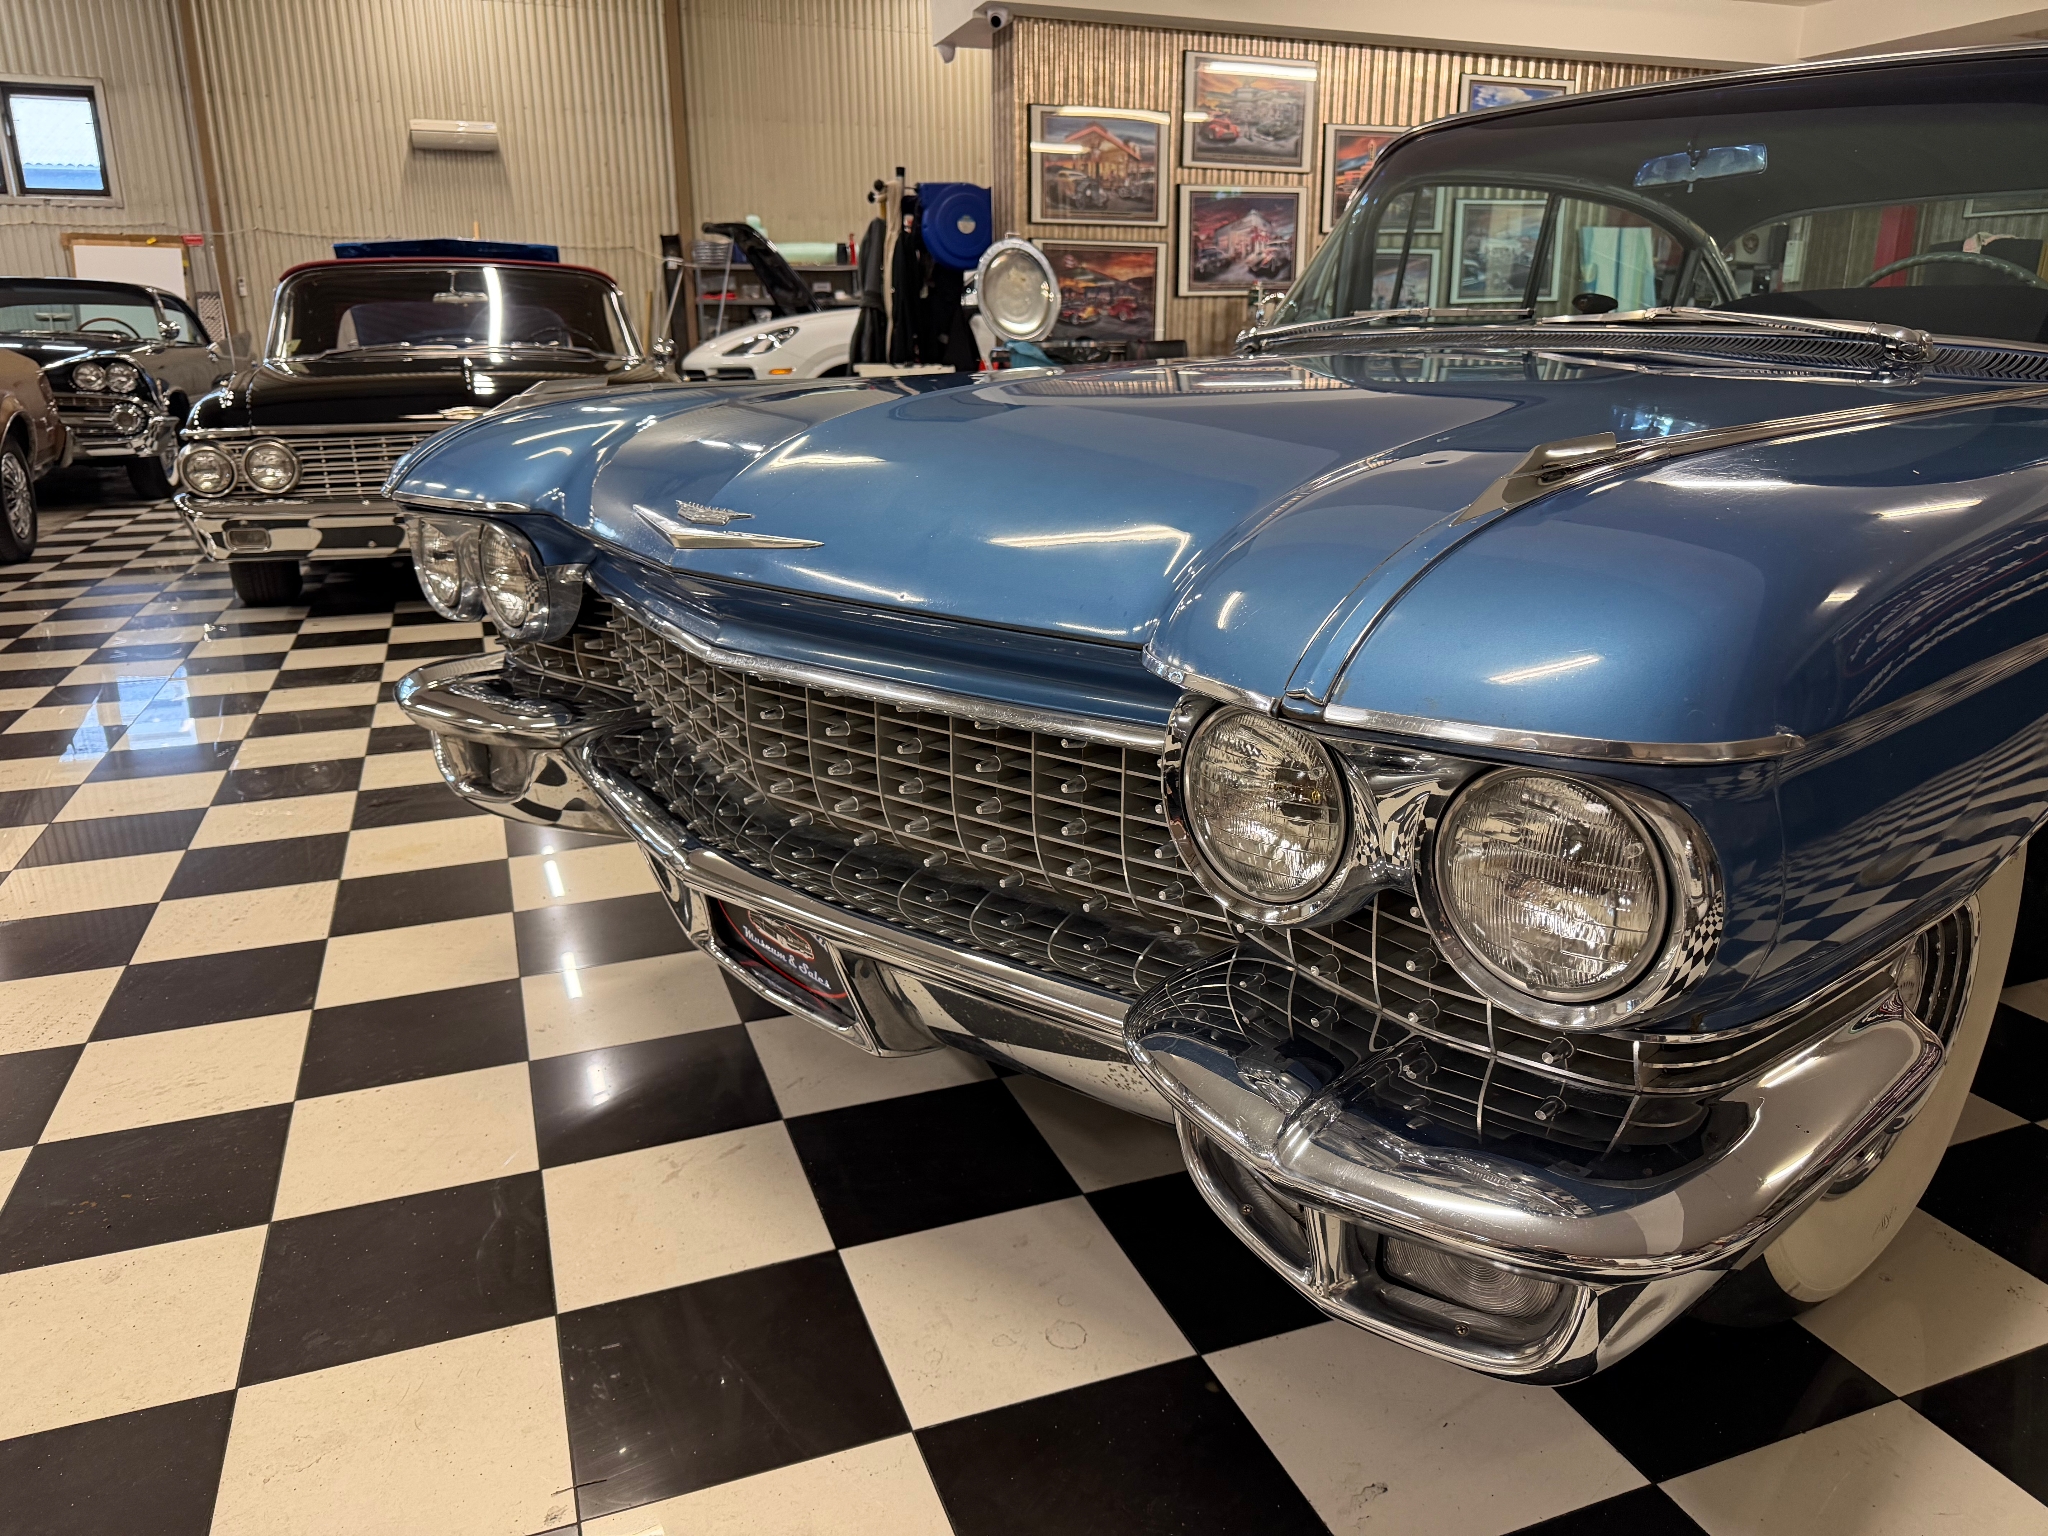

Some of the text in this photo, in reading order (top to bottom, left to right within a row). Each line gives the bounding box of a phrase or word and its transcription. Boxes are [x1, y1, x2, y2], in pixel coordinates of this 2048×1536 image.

[742, 925, 787, 962] Museum
[788, 955, 798, 969] &
[799, 962, 831, 989] Sales
